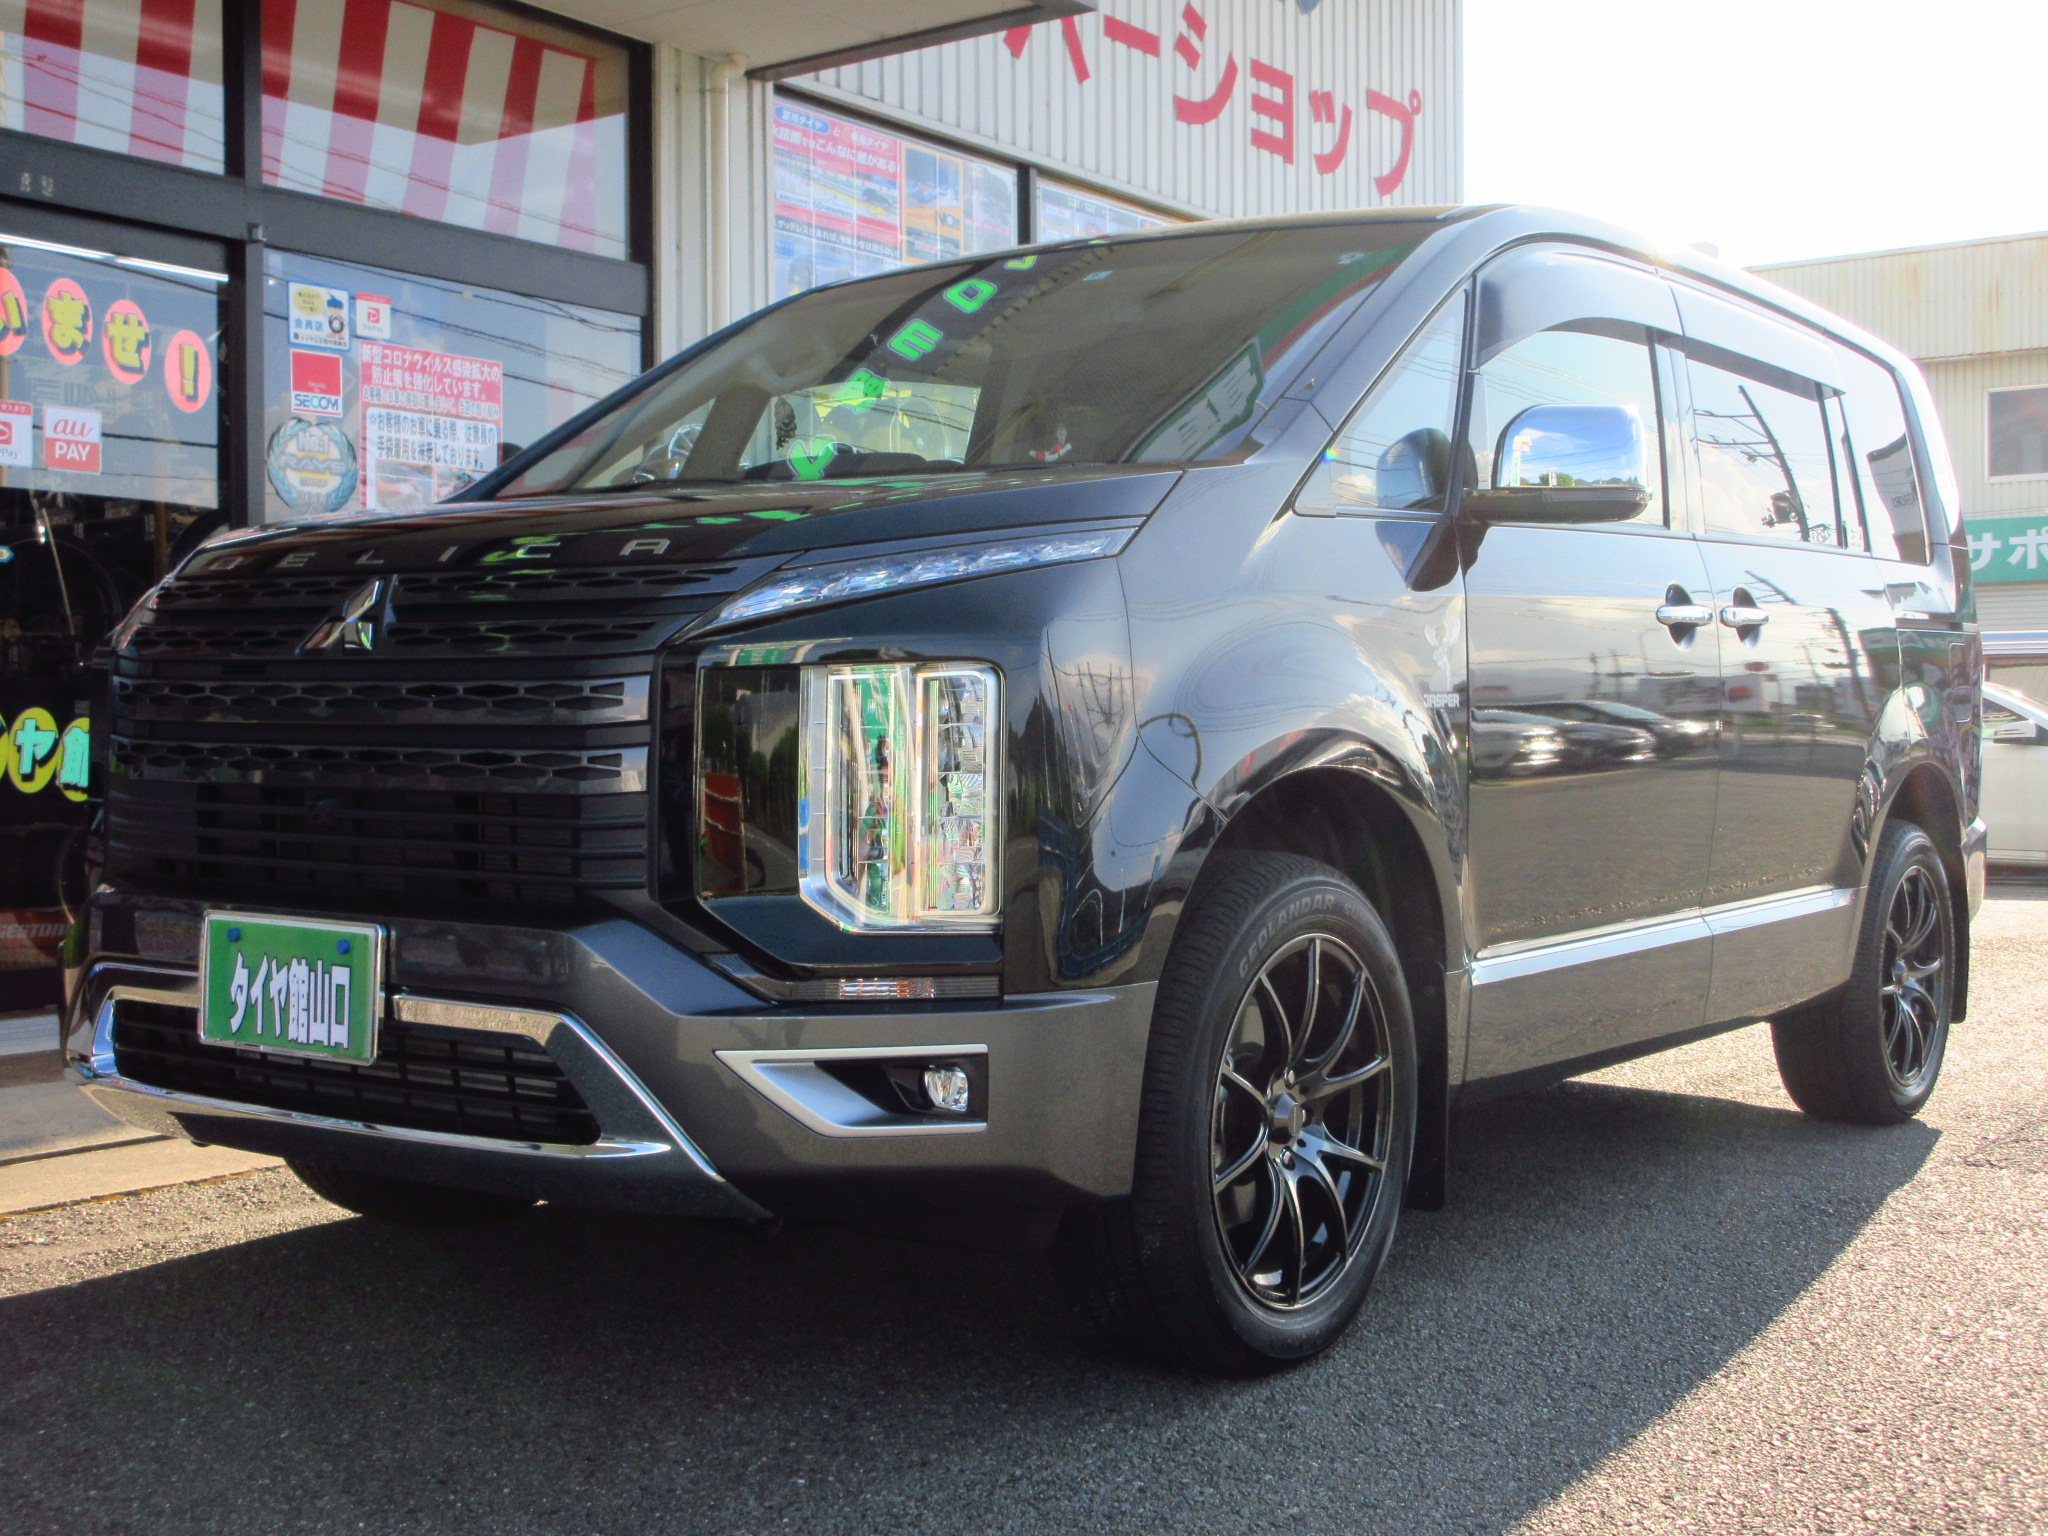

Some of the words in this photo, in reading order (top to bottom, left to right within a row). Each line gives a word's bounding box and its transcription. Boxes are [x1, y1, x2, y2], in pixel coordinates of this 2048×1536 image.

[294, 393, 339, 411] SECOM
[53, 418, 93, 438] au
[54, 441, 91, 462] PAY
[203, 536, 671, 571] DELICA
[1423, 694, 1460, 708] JASPER
[1238, 893, 1336, 979] GEOLANDAR
[229, 951, 351, 1049] タイヤ館山口
